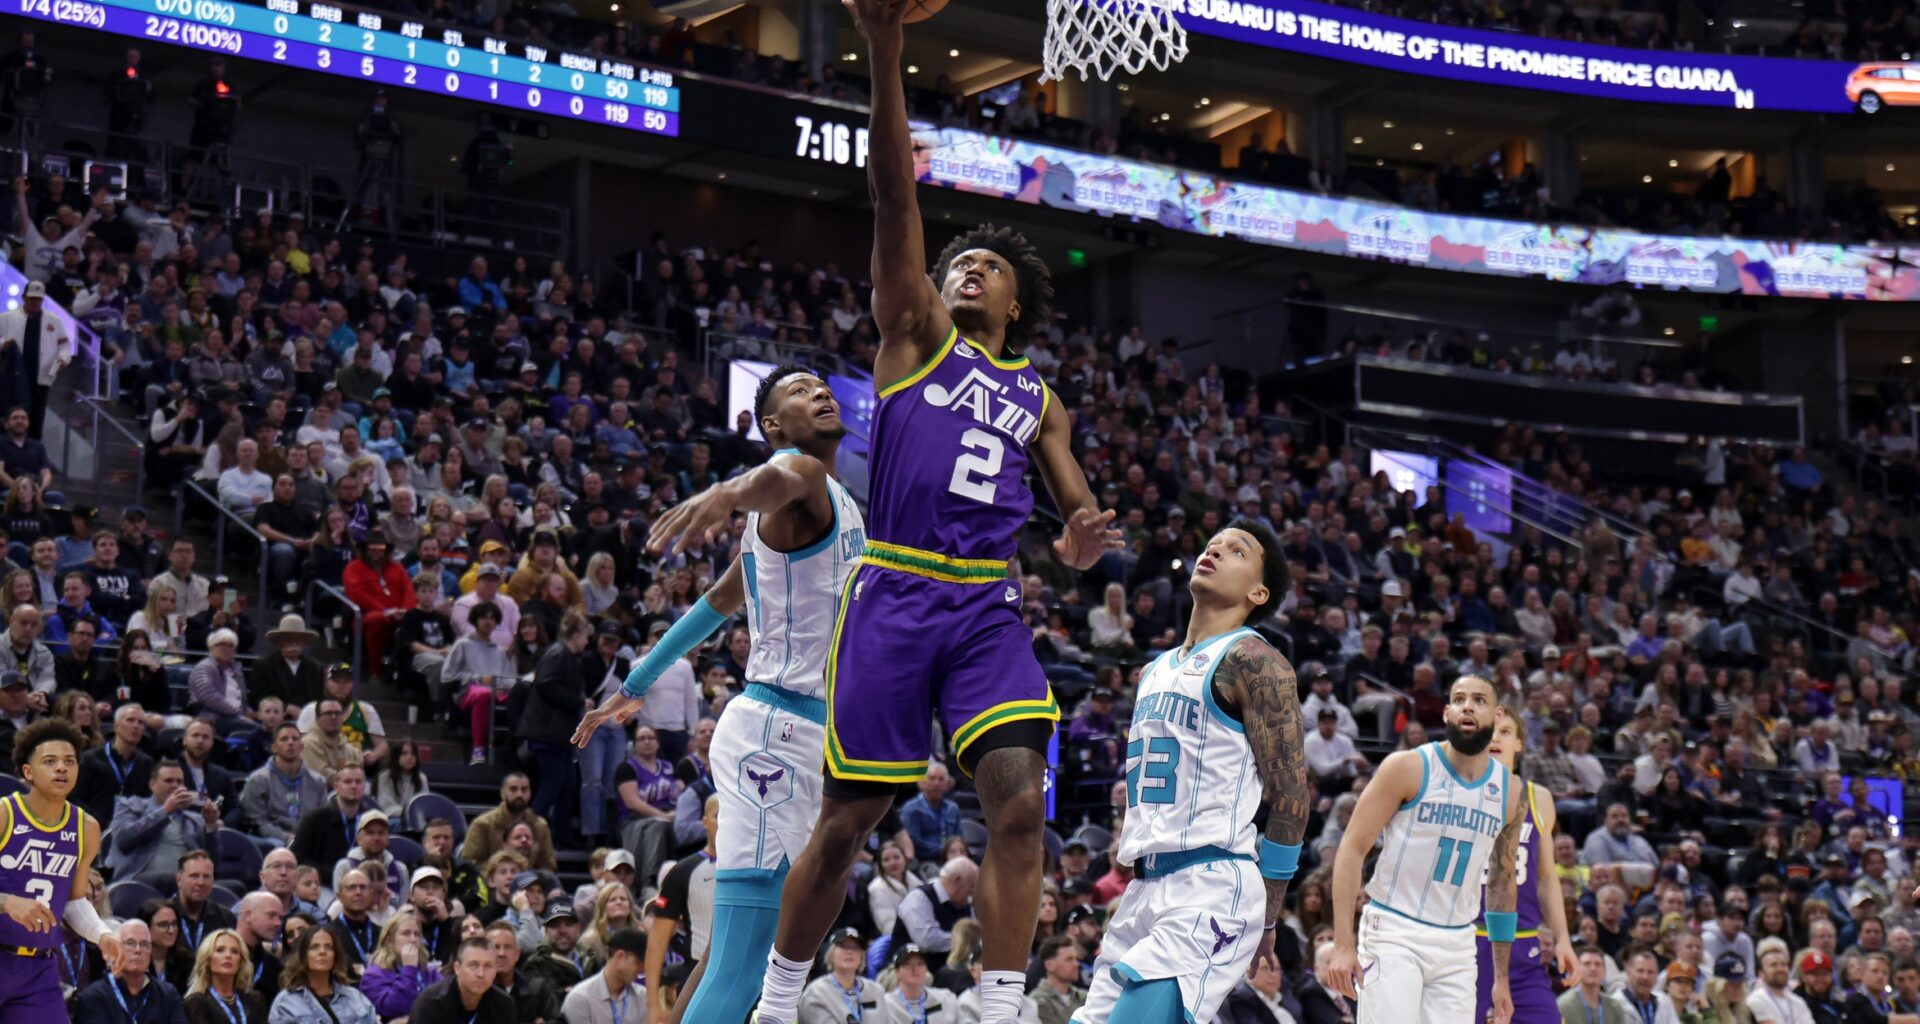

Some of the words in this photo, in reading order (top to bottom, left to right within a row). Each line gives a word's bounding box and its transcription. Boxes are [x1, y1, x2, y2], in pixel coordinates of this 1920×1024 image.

[195, 0, 235, 26] (0%)
[274, 16, 288, 33] 0
[319, 24, 332, 42] 2
[362, 32, 375, 51] 2
[407, 42, 415, 59] 1
[446, 49, 460, 66] 0
[490, 58, 499, 75] 1
[529, 65, 541, 83] 2
[571, 73, 584, 91] 0
[605, 80, 628, 99] 50
[644, 87, 668, 107] 119
[311, 3, 342, 23] DREB
[358, 13, 381, 30] REB
[401, 22, 423, 38] AST
[443, 30, 465, 47] STL
[484, 37, 507, 55] BLK
[560, 53, 597, 73] BENCH
[1188, 0, 1273, 31] SUBARU
[1276, 10, 1297, 35] IS
[1298, 14, 1340, 45] THE
[1342, 24, 1405, 56] HOME
[1407, 36, 1439, 60] OF
[1441, 41, 1485, 67] THE
[1487, 46, 1586, 80] PROMISE
[1587, 59, 1652, 87] PRICE
[53, 0, 106, 28] (25%)
[146, 17, 180, 40] 2/2
[182, 23, 242, 53] (100%)
[273, 41, 287, 60] 2
[318, 49, 331, 68] 3
[361, 58, 374, 76] 5
[404, 66, 416, 84] 2
[446, 73, 459, 92] 0
[489, 81, 498, 99] 1
[527, 88, 541, 107] 0
[570, 96, 584, 115] 0
[604, 105, 629, 123] 119
[644, 111, 666, 130] 50
[795, 116, 850, 164] 7:16
[855, 128, 868, 167] P
[1017, 374, 1041, 396] LVT
[949, 428, 1005, 504] 2
[1132, 692, 1200, 731] HARLOTTE
[60, 831, 77, 842] LVT
[1417, 802, 1501, 839] CHARLOTTE
[1, 838, 78, 878] JAZZ
[1433, 836, 1473, 887] 11
[25, 878, 54, 908] 3
